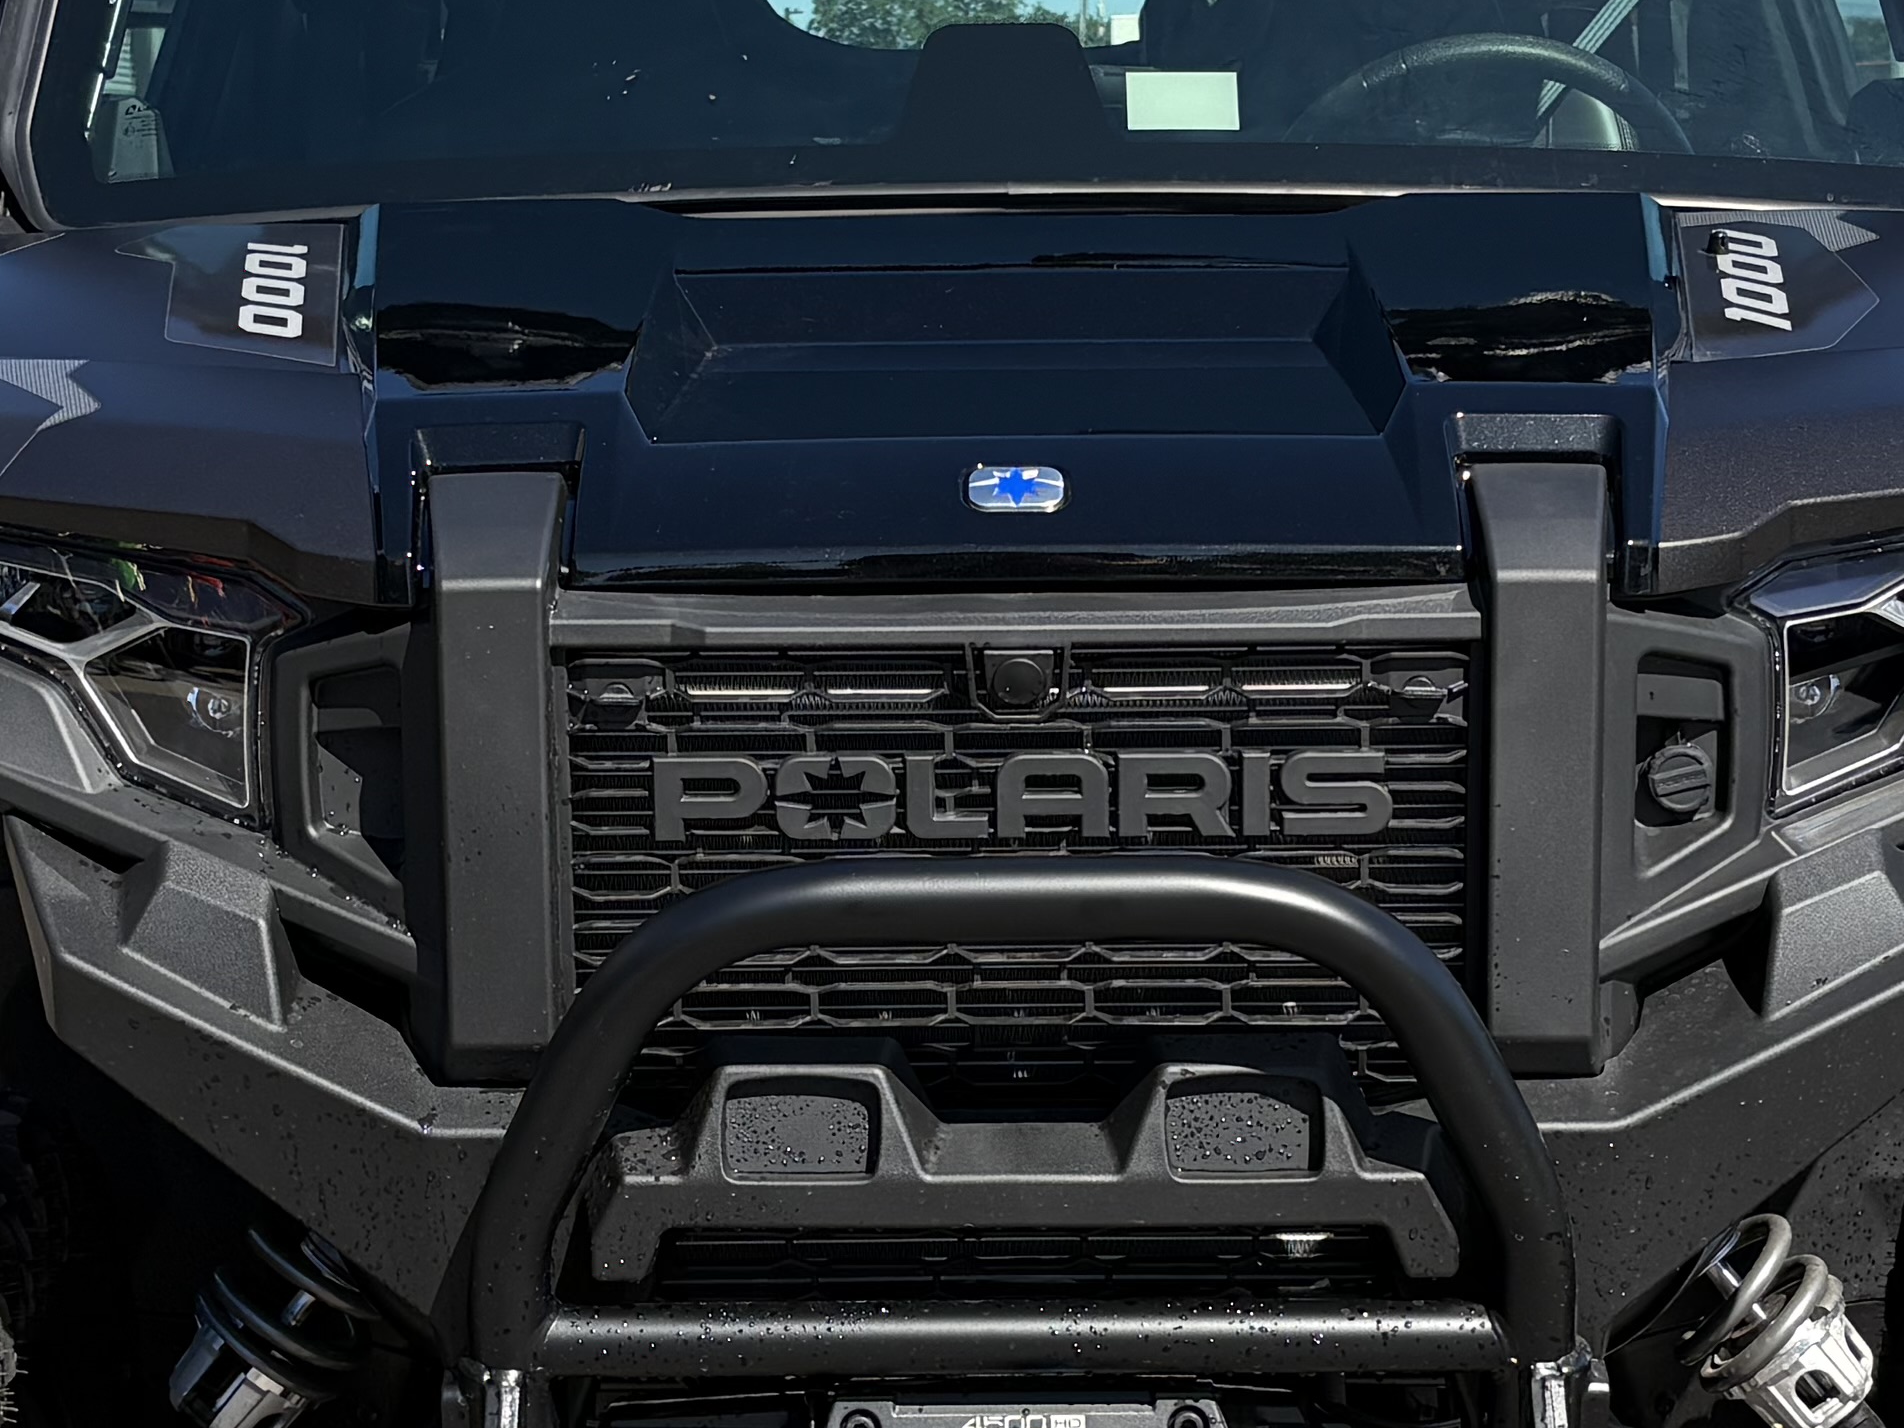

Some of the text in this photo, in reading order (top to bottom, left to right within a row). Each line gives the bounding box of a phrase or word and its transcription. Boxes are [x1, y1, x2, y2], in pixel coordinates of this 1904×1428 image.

[238, 242, 308, 338] 1000
[1712, 228, 1792, 331] 1000
[652, 749, 1394, 842] POLARIS
